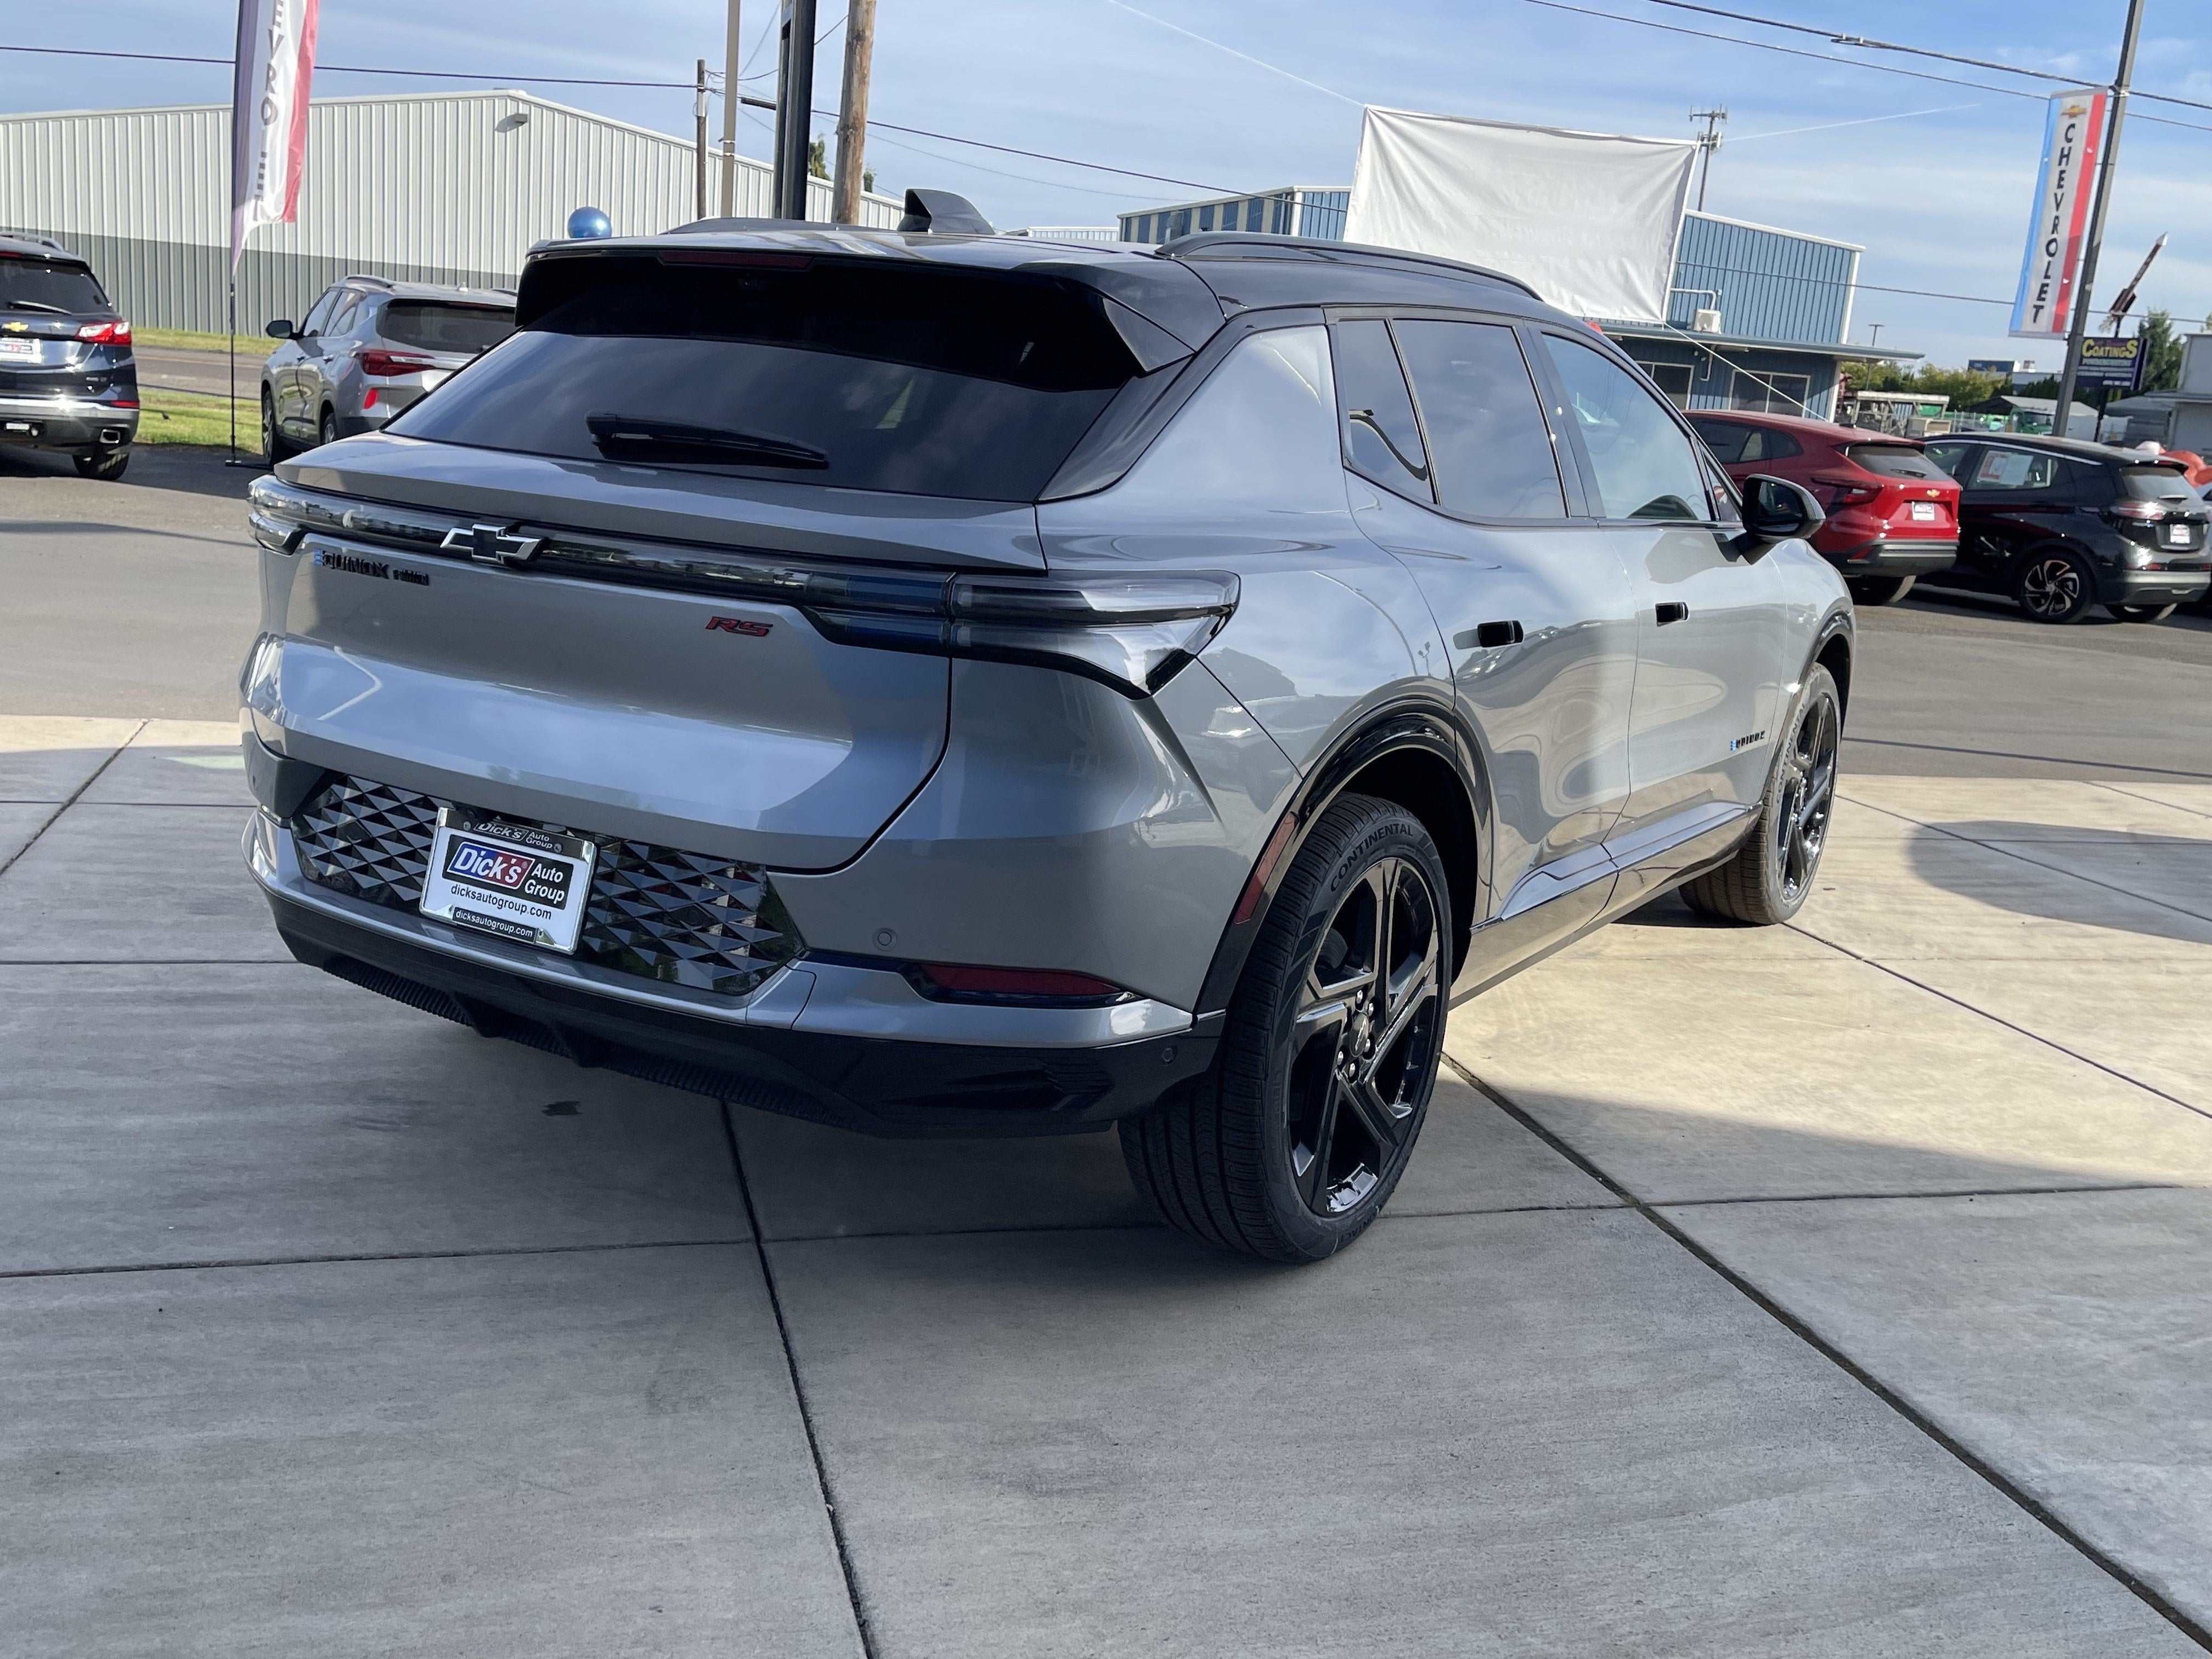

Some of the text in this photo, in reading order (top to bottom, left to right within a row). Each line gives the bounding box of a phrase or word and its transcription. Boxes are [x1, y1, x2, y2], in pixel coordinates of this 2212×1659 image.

[2033, 123, 2075, 324] CHEVROLET
[706, 616, 774, 636] RS
[526, 837, 553, 849] Group
[528, 831, 550, 842] Auto
[454, 849, 563, 884] Dick's Auto
[1330, 823, 1414, 892] CONTINENTAL
[451, 884, 552, 920] dicksautogroup.com
[524, 879, 565, 905] Group
[456, 909, 533, 938] dicksautogroup.com
